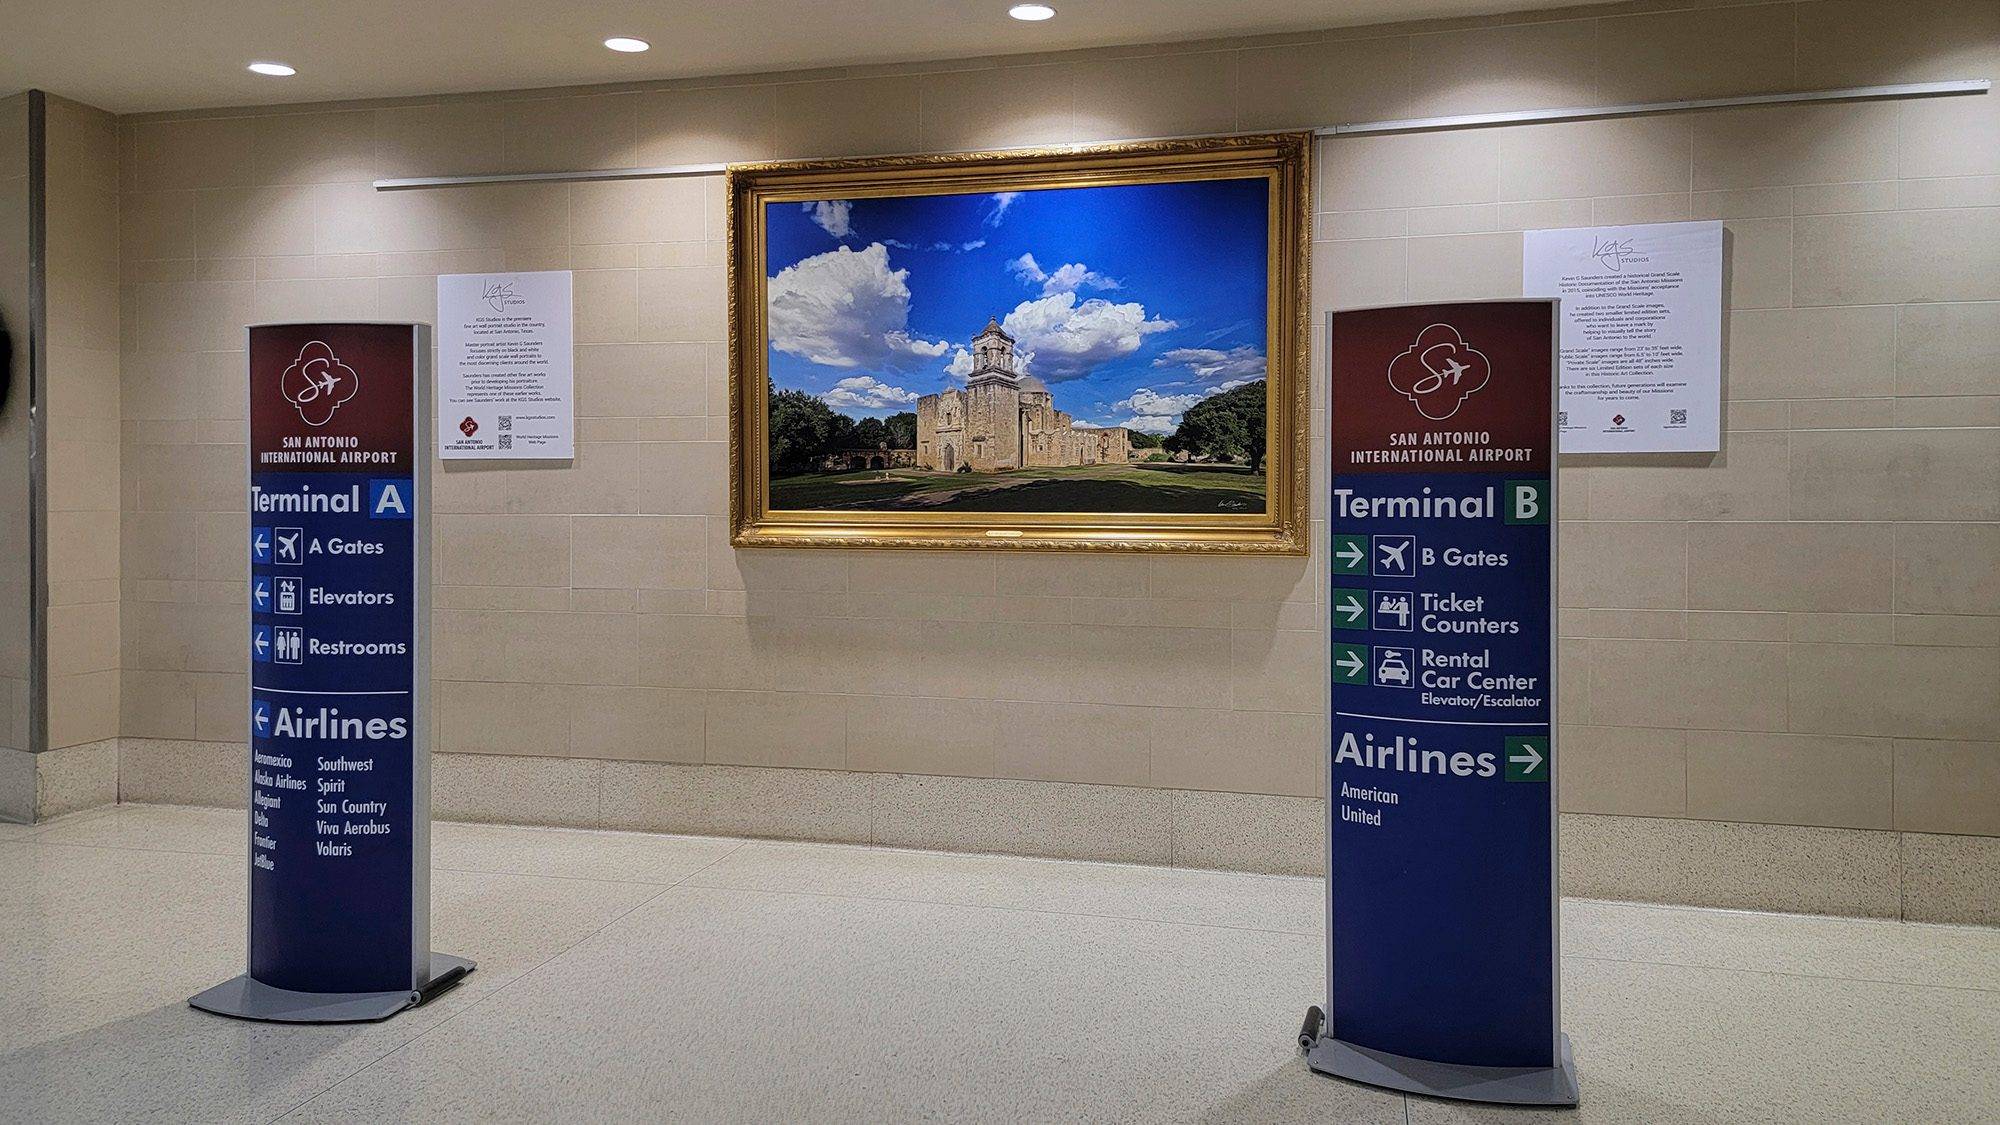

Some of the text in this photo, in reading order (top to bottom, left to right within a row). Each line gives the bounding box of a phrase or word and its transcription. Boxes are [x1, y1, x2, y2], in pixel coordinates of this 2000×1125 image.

[283, 437, 358, 448] SAN ANTONIO
[1390, 432, 1490, 445] SAN ANTONIO
[261, 452, 397, 464] INTERNATIONAL AIRPORT
[1351, 449, 1533, 464] INTERNATIONAL AIRPORT
[252, 484, 406, 513] Terminal A
[1334, 486, 1539, 519] Terminal B
[309, 539, 384, 555] A Gates
[1422, 548, 1508, 567] B Gates
[310, 589, 395, 605] Elevators
[1420, 593, 1484, 612] Ticket
[1421, 616, 1519, 634] Counters
[309, 638, 406, 656] Restrooms
[1422, 649, 1489, 668] Rental
[1421, 671, 1537, 690] Car Center
[1421, 693, 1541, 709] Elevator/Escalator
[274, 708, 408, 740] Airlines
[254, 749, 292, 768] Aeromexico
[1334, 732, 1496, 777] Airlines
[317, 757, 373, 772] Southwest
[254, 769, 307, 791] Alaska Airlines
[317, 778, 345, 794] Spirit
[254, 791, 281, 810] Allegiant
[1341, 782, 1399, 804] American
[317, 799, 387, 816] Sun Country
[1341, 805, 1381, 826] United
[254, 811, 268, 828] Delta
[317, 821, 391, 835] Viva Aerobus
[254, 832, 277, 851] Frontier
[317, 842, 352, 857] Volaris
[254, 852, 274, 871] JetBlue
